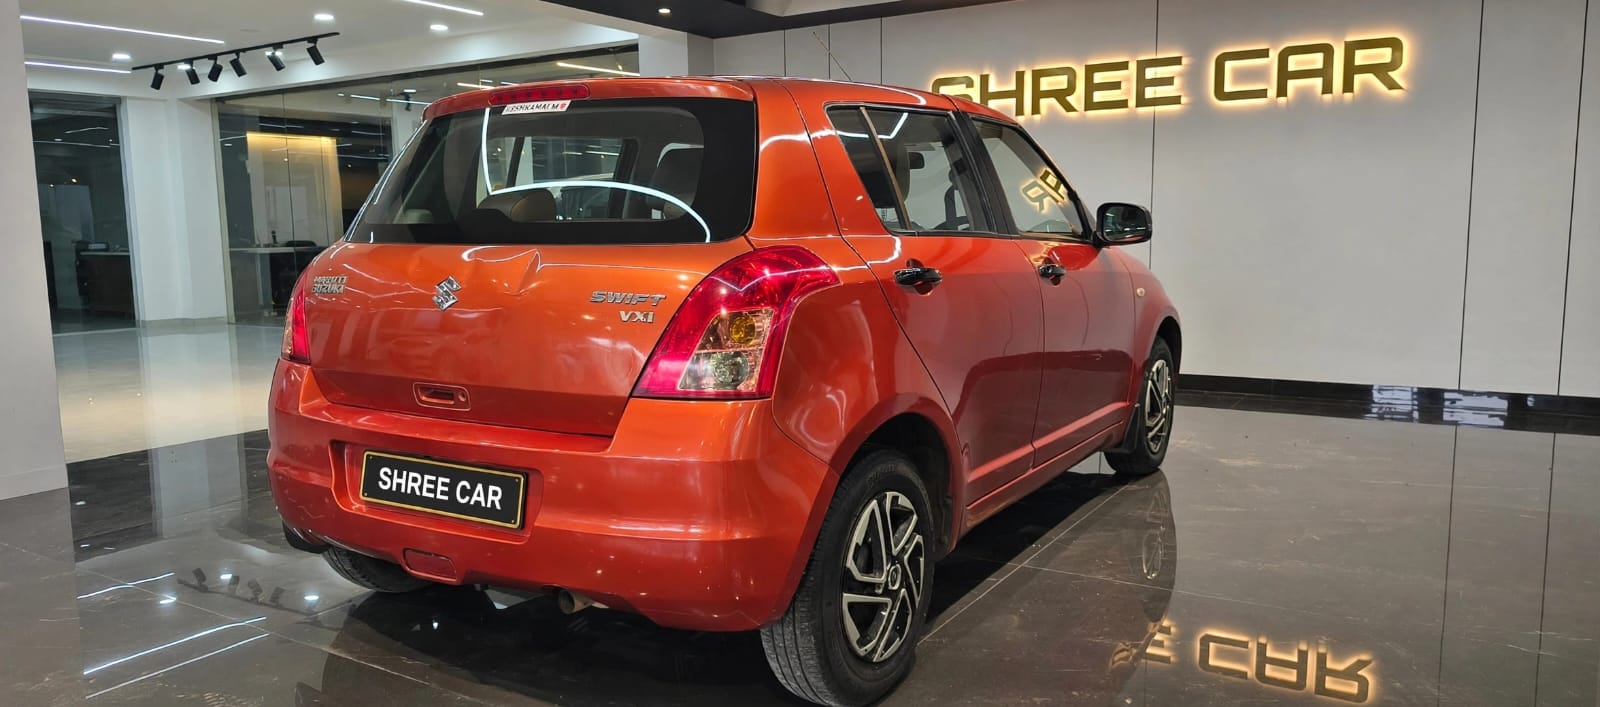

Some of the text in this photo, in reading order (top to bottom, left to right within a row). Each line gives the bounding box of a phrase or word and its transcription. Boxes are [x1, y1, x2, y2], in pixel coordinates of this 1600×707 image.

[1214, 36, 1404, 101] CAR
[312, 284, 345, 294] SUZUKI
[590, 290, 666, 306] SWIFT
[378, 467, 503, 510] SHREE CAR
